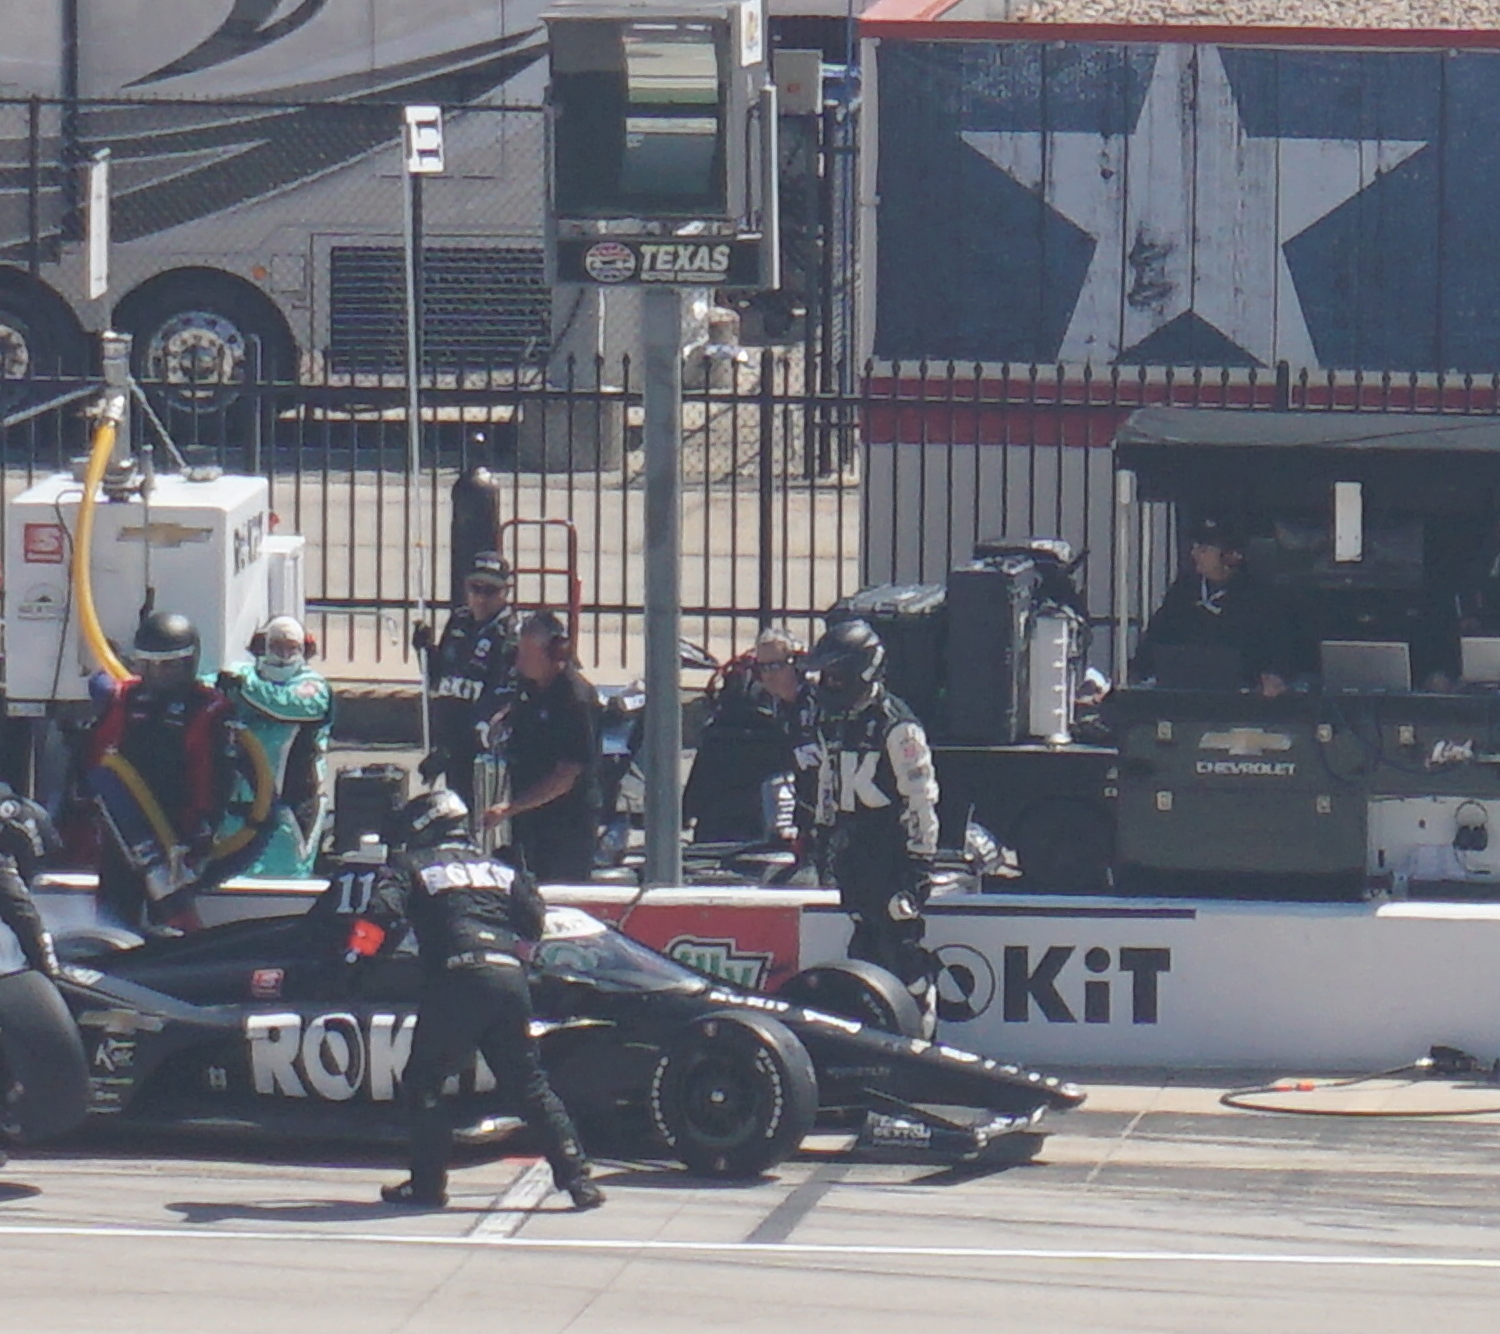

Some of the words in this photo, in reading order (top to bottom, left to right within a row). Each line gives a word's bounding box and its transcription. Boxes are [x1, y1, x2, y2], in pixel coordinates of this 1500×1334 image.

[639, 244, 731, 271] TEXAS
[1195, 760, 1297, 776] CHEVROLET
[336, 872, 377, 914] 11
[934, 944, 1172, 1025] OKiT
